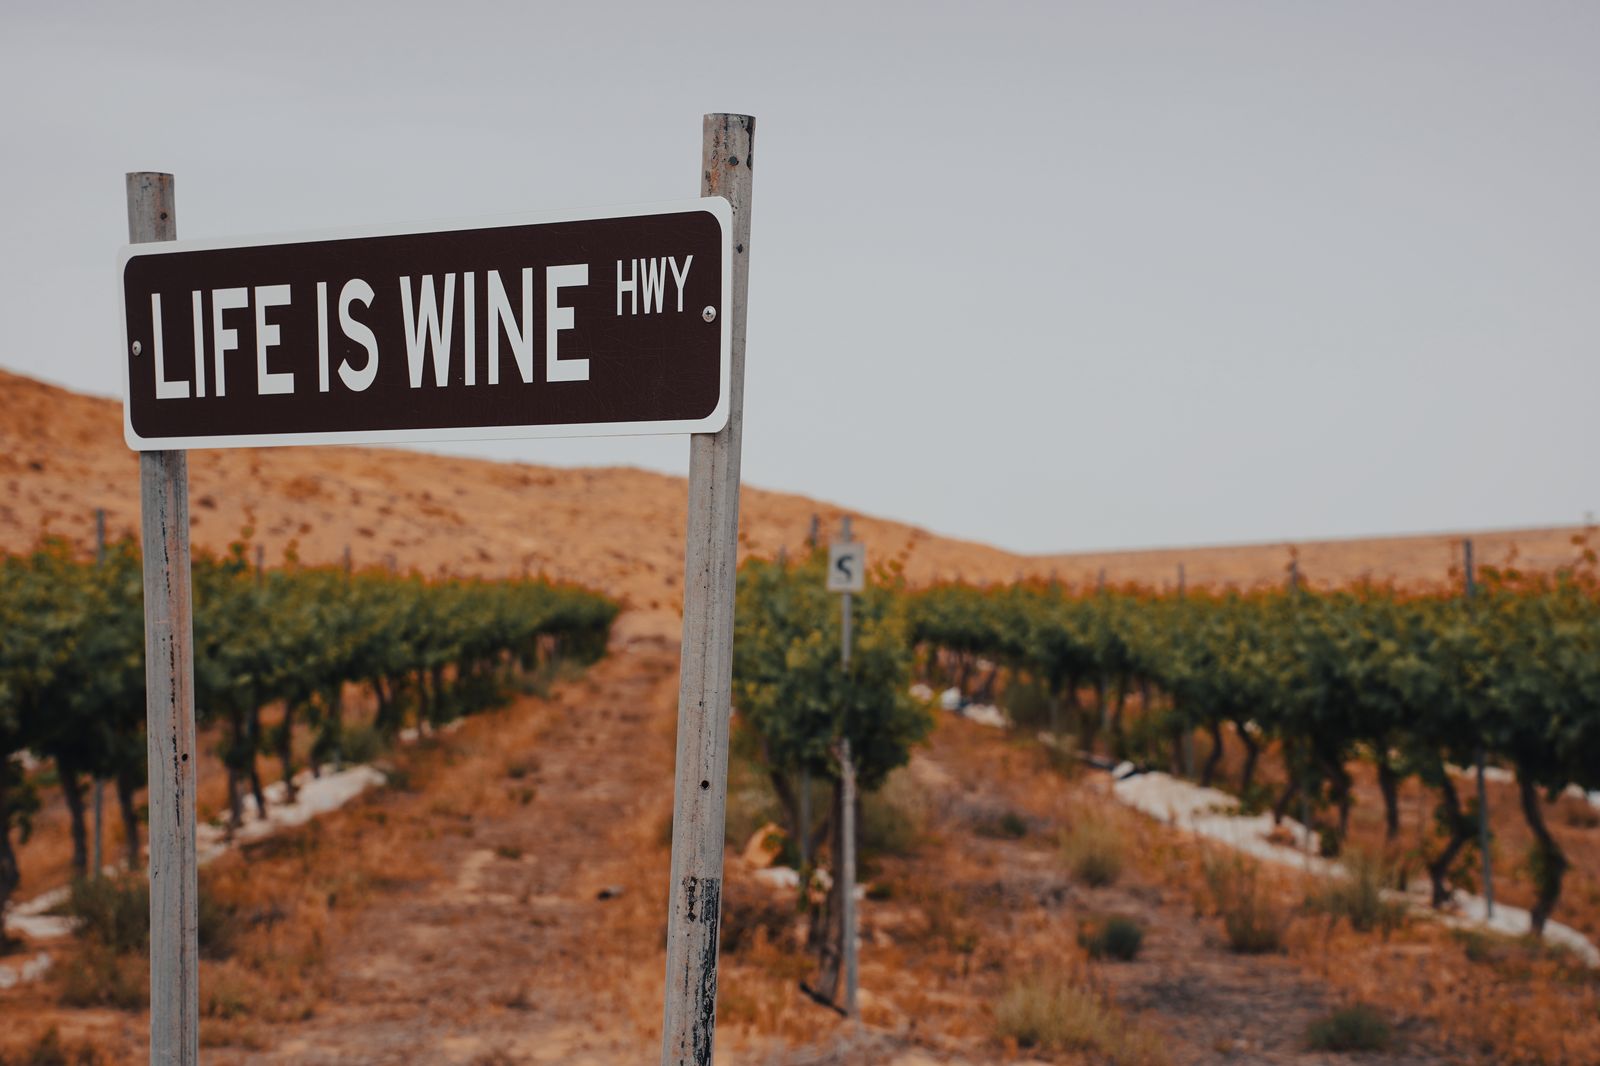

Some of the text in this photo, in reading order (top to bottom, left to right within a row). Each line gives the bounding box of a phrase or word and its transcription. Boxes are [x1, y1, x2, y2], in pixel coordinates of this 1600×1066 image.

[151, 254, 694, 400] LIFE IS WINE HWY
